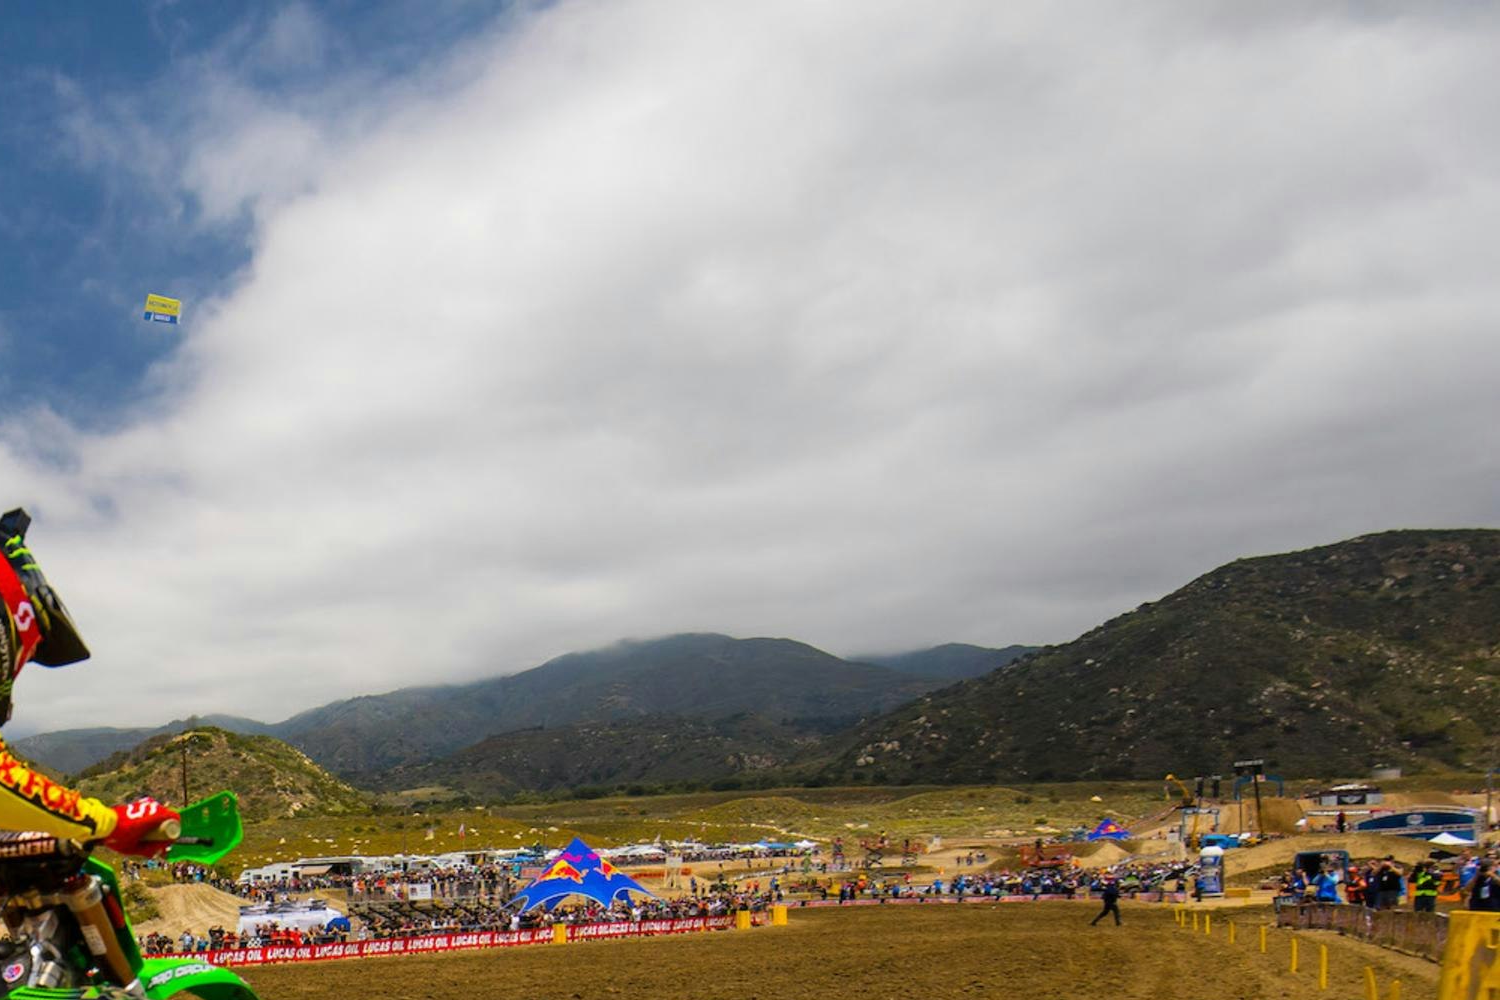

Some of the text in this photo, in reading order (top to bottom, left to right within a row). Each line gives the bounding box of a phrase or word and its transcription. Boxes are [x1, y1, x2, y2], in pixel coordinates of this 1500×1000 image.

[451, 933, 491, 946] LUCAS OIL
[494, 931, 532, 944] LUCAS OIL
[534, 928, 554, 939] LUCA
[363, 940, 404, 953] LUCAS OIL
[407, 937, 448, 950] LUCAS OIL
[214, 948, 263, 963] LUCAS OIL
[267, 946, 311, 959] LUCAS OIL
[315, 944, 360, 957] LUCAS OIL
